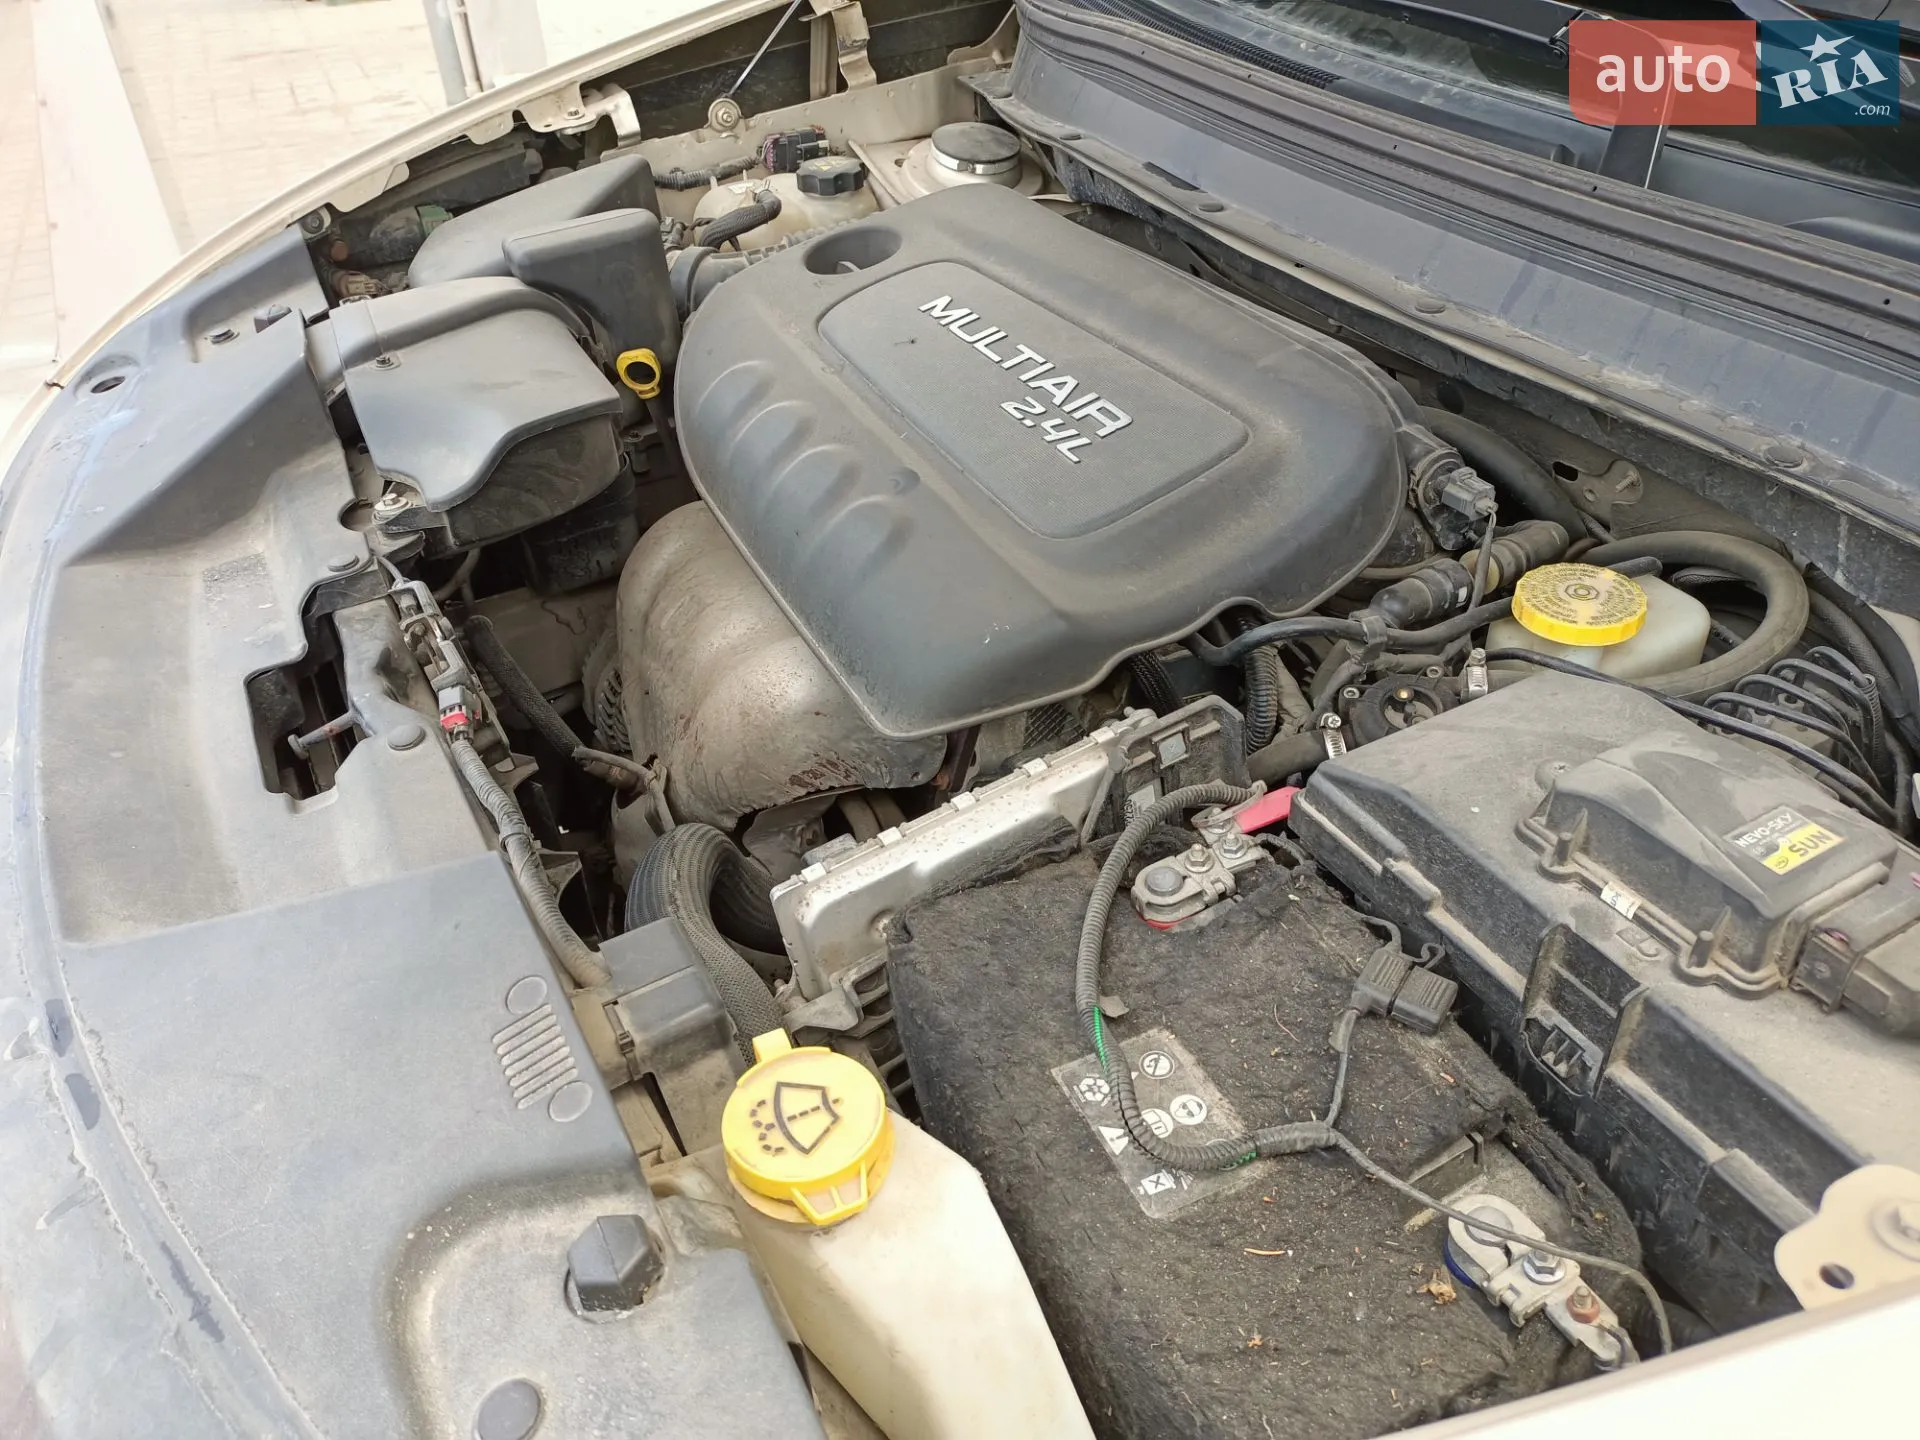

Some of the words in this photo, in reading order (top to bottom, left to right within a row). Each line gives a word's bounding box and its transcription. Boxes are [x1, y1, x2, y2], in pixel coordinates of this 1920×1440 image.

[918, 295, 1134, 439] MULTIAIR
[1000, 396, 1093, 464] 2.4L
[1788, 830, 1828, 857] SUN
